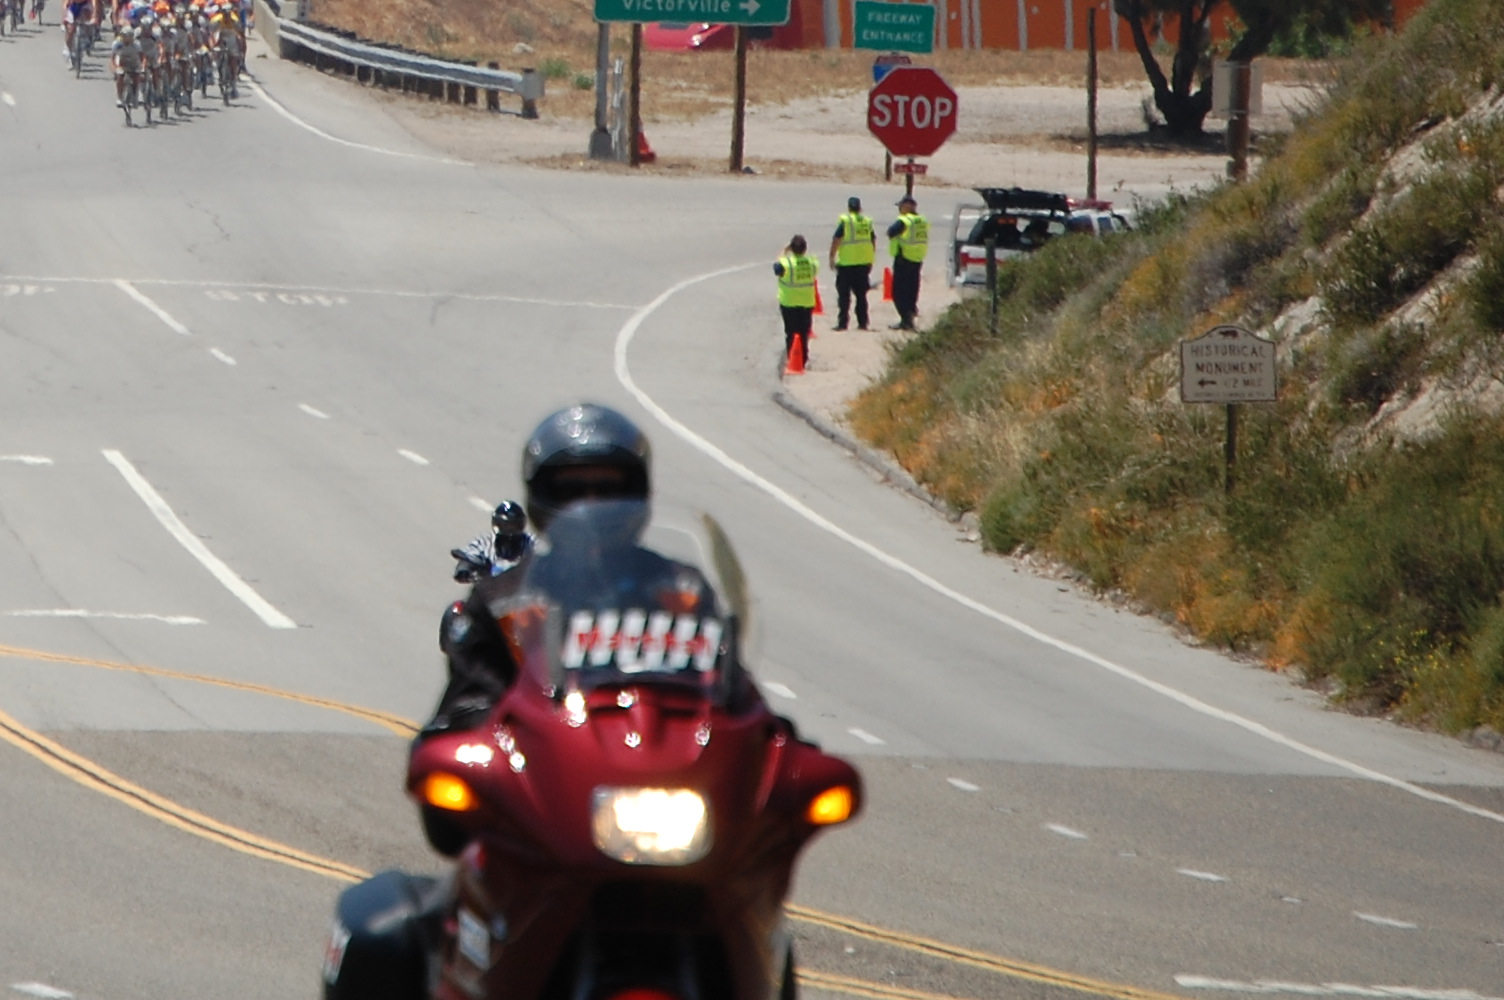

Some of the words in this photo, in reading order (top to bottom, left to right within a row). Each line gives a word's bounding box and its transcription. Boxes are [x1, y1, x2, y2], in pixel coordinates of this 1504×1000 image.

[867, 11, 923, 25] FREEWAY
[862, 30, 925, 44] ENTRANCE
[872, 94, 953, 129] STOP
[1190, 344, 1266, 358] HISTORICAL
[1195, 362, 1264, 375] MONUMENT
